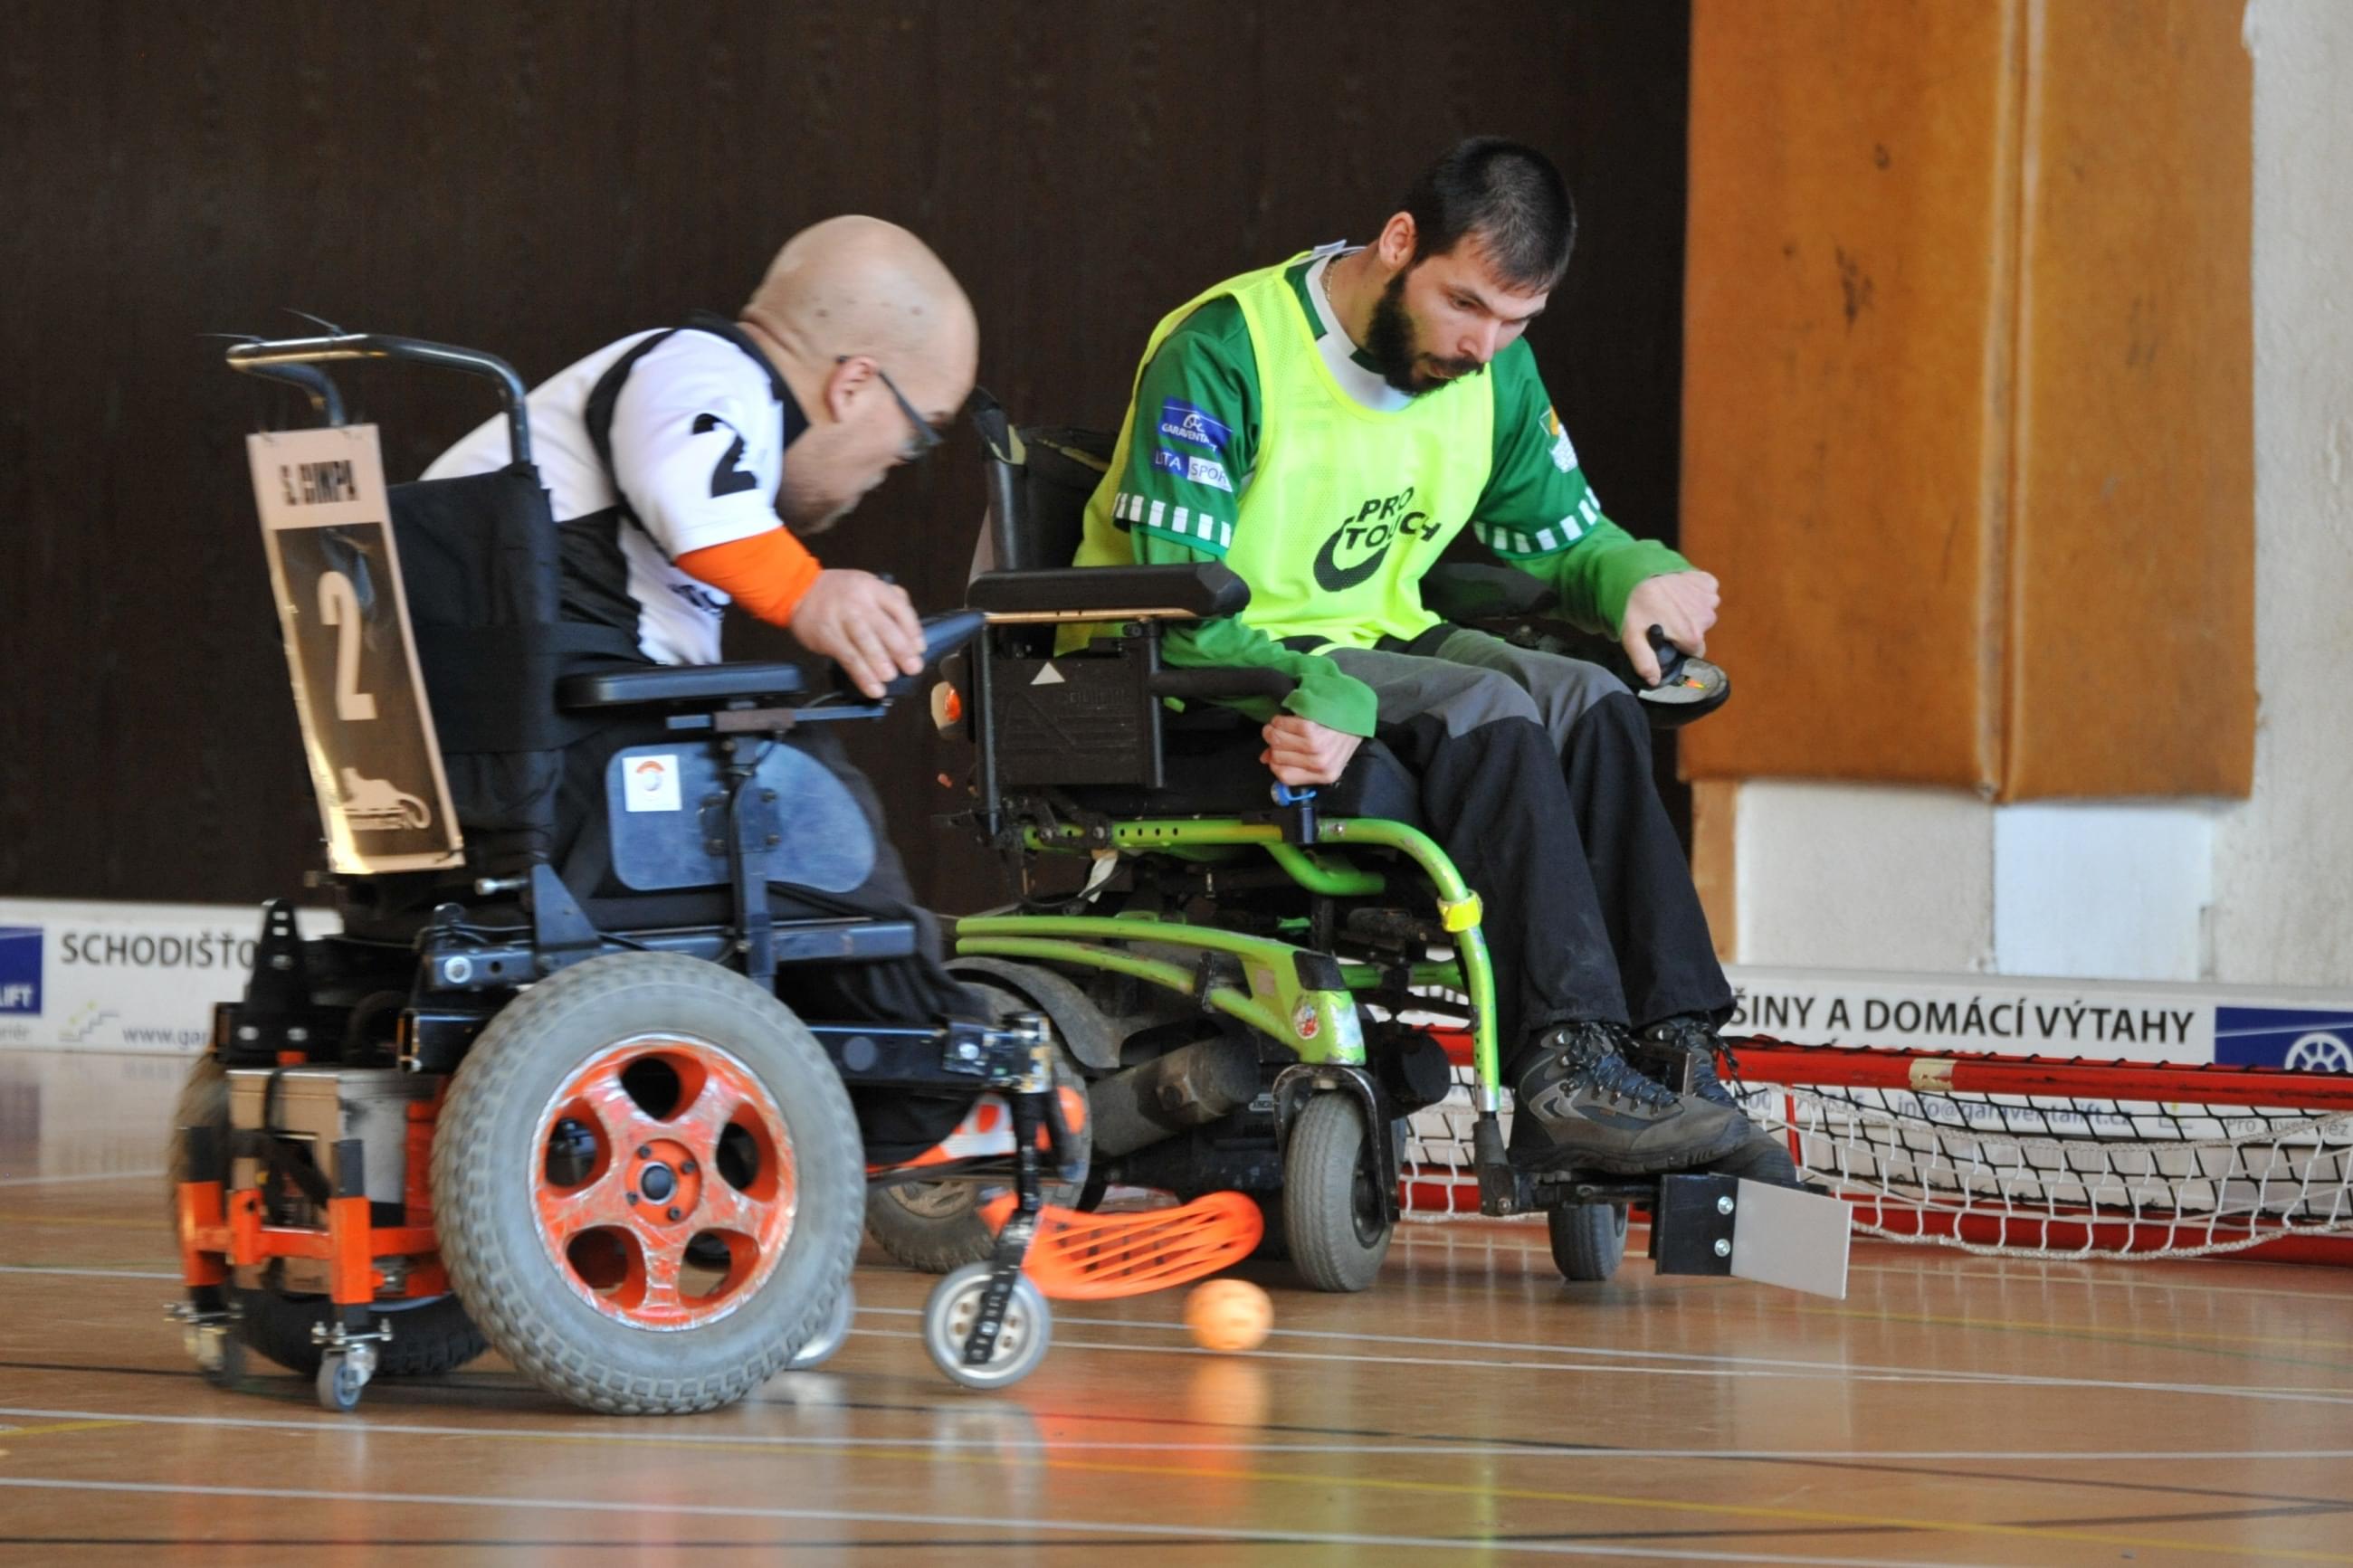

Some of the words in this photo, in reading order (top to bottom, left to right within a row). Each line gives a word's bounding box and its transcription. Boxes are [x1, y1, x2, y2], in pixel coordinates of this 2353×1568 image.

[692, 413, 757, 499] 2
[1357, 486, 1415, 522] PRO
[1346, 511, 1443, 551] TOUCH
[317, 570, 378, 721] 2
[1825, 998, 1851, 1031] A
[1863, 995, 2026, 1037] DOMÁCÍ
[2034, 999, 2195, 1044] VÝTAHY
